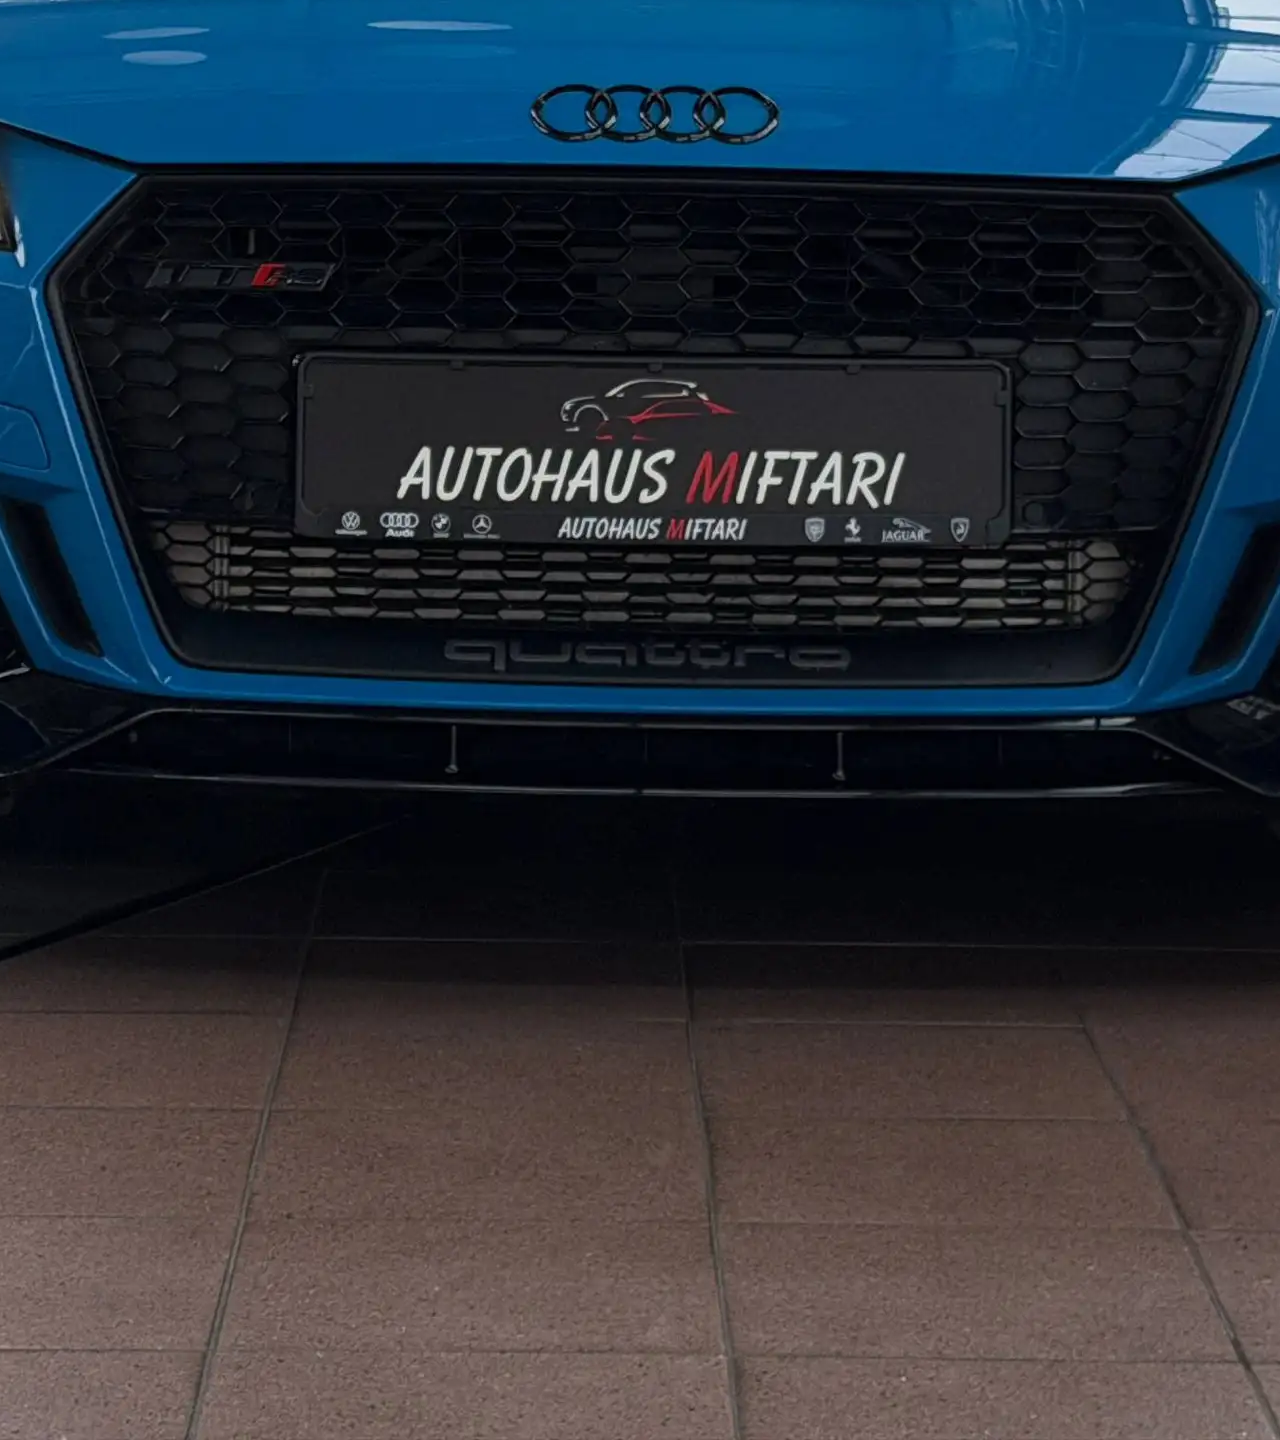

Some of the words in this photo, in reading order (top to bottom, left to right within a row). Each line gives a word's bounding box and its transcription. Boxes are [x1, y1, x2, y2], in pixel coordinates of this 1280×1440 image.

[396, 445, 676, 504] AUTOHAUS
[685, 450, 906, 509] MIFTARI
[557, 517, 663, 541] AUTOHAUS
[665, 518, 749, 541] MIFTARI
[443, 638, 853, 673] quattro
